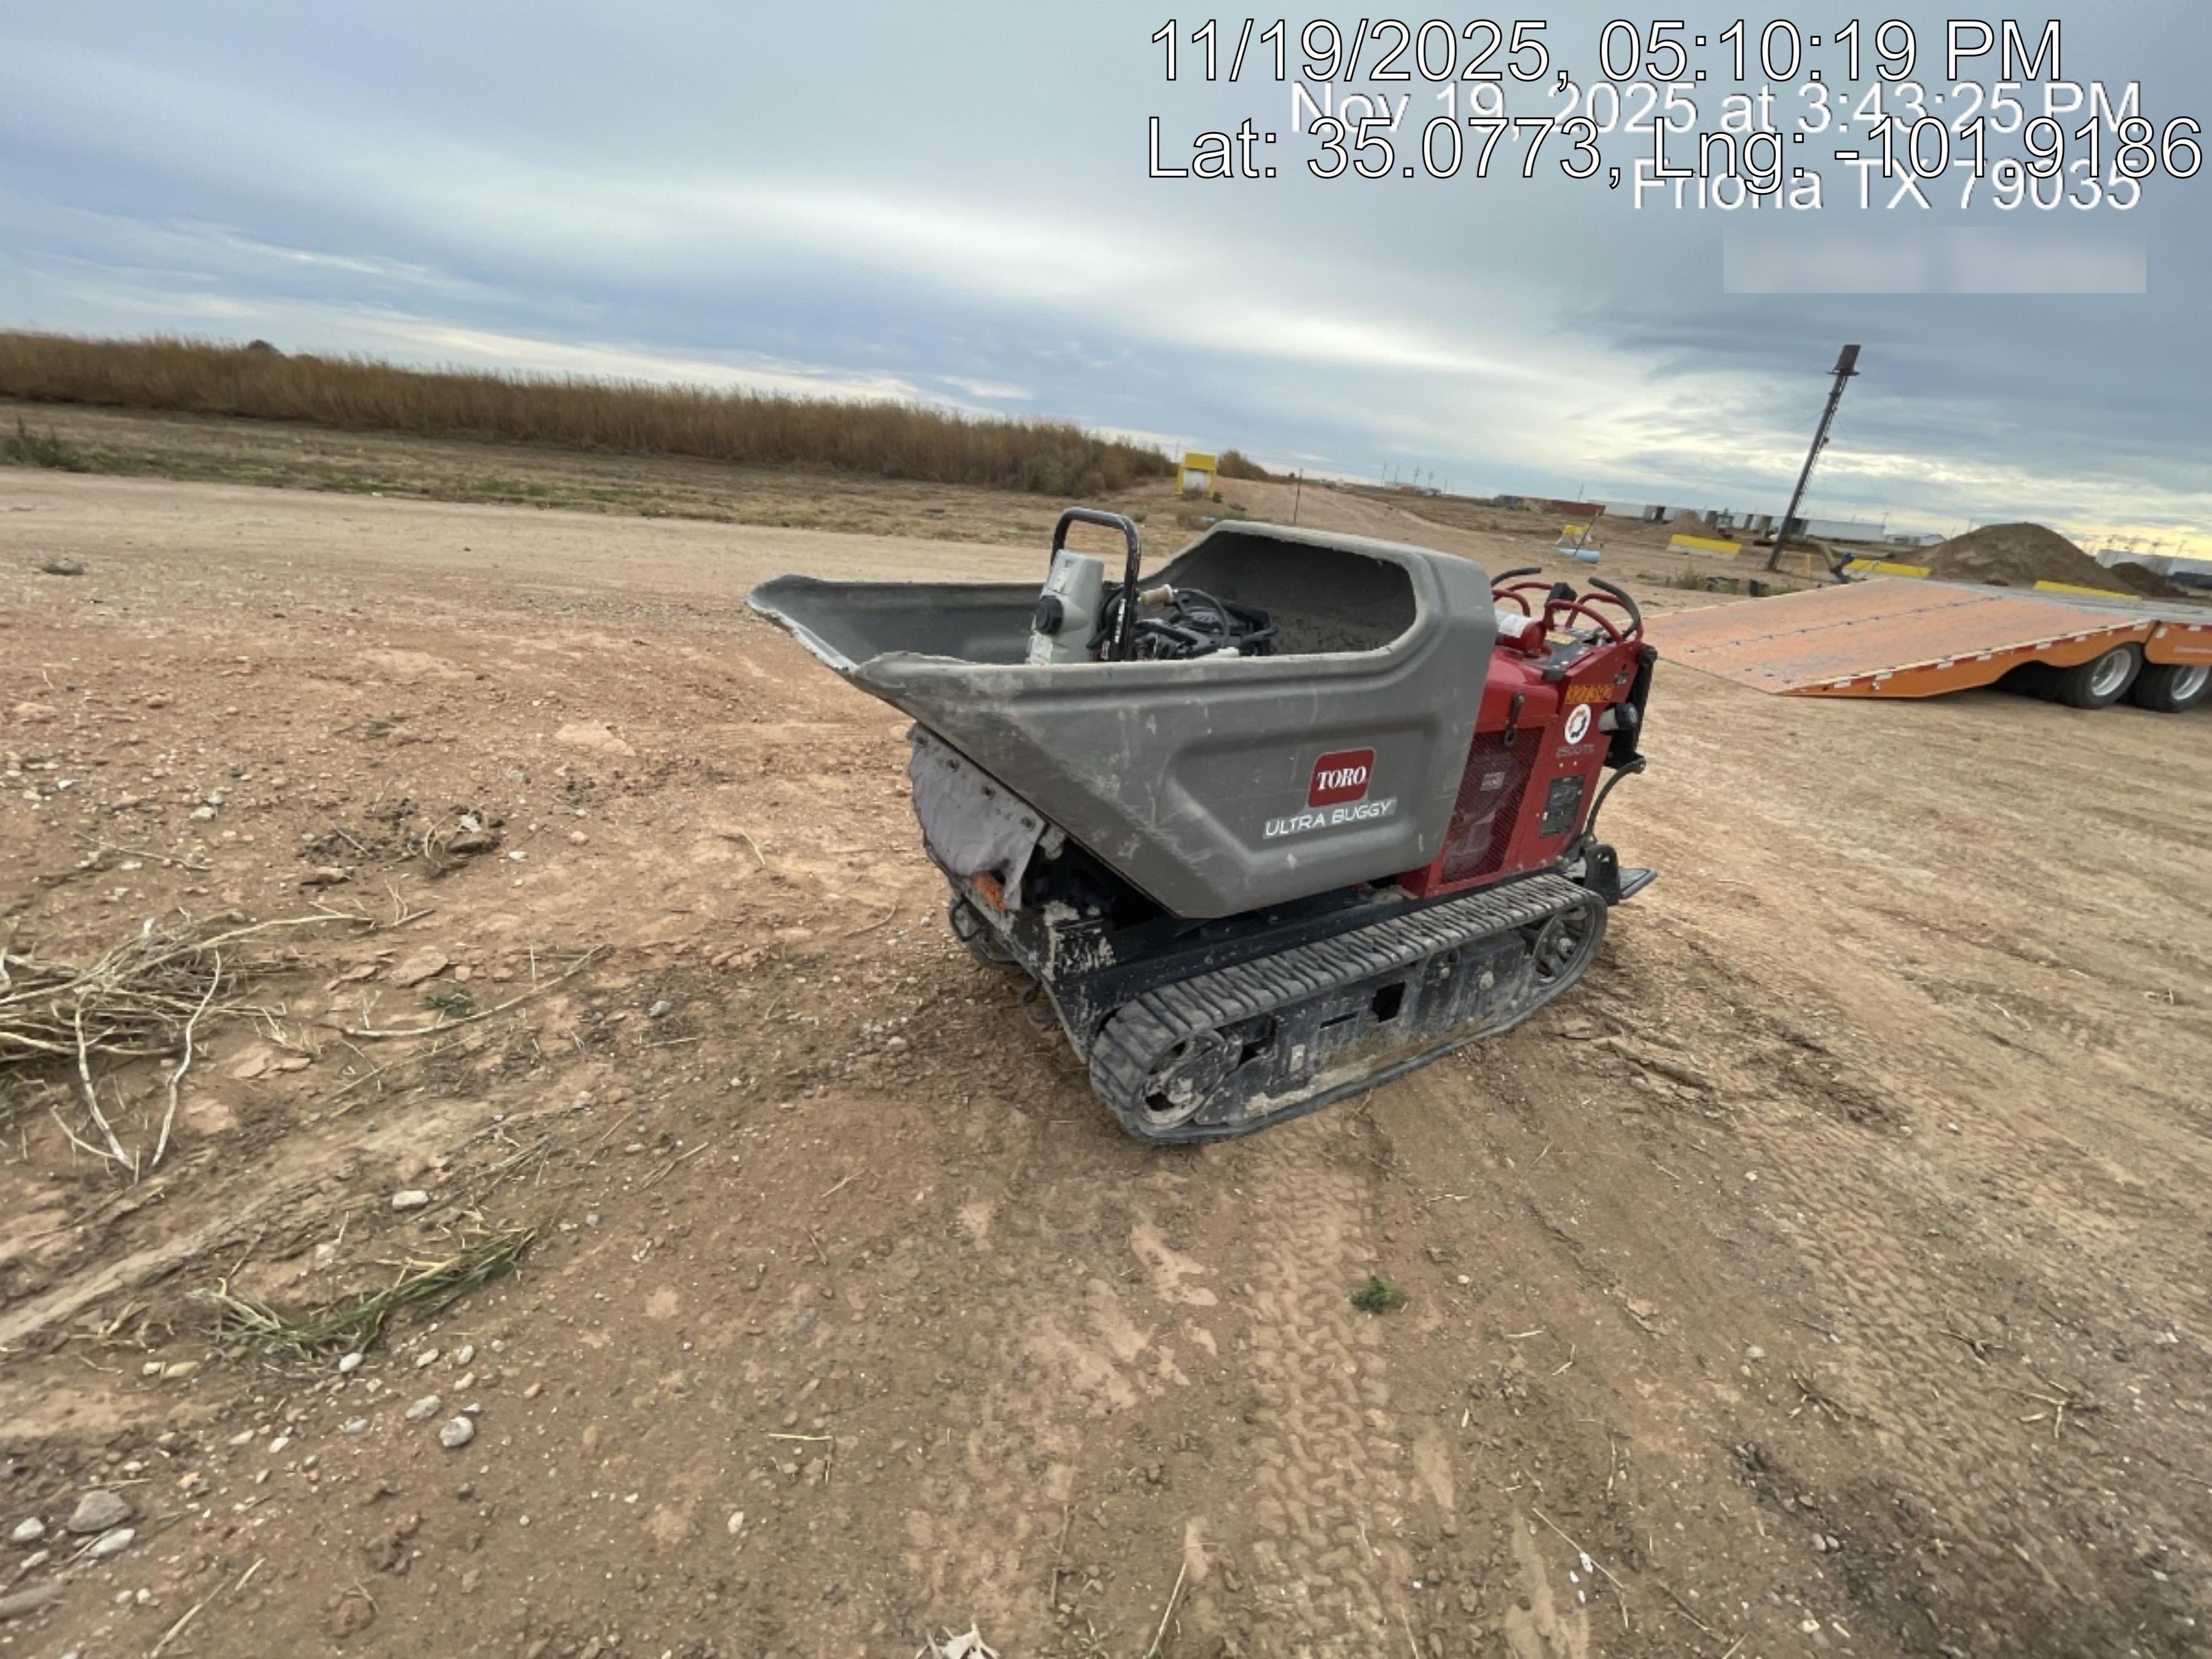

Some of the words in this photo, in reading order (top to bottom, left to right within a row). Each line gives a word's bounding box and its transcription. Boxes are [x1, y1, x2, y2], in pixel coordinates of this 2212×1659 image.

[1317, 766, 1367, 791] TORO
[1265, 813, 1327, 836] ULTRA
[1331, 801, 1392, 824] BUGGY
